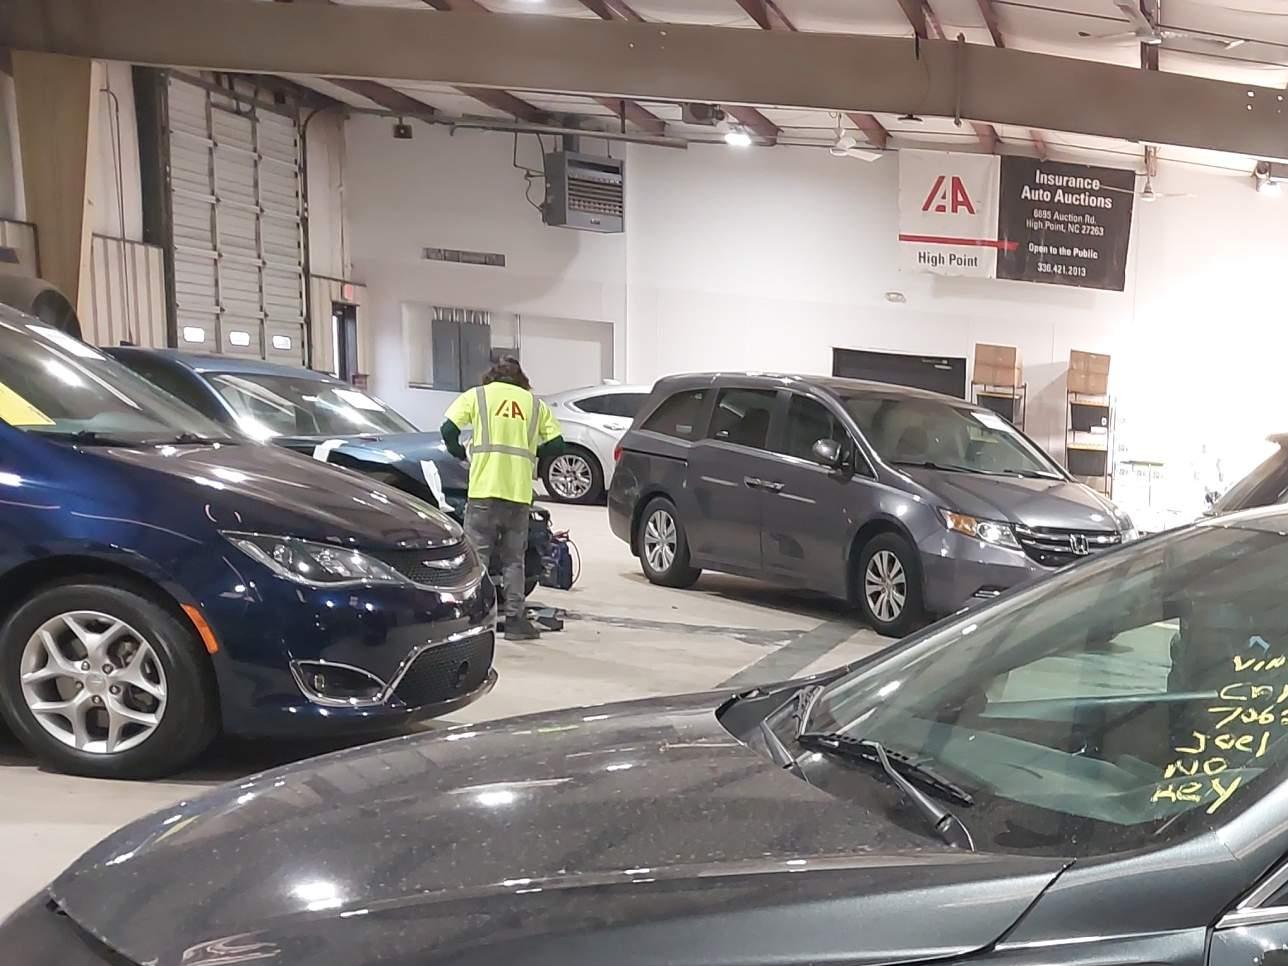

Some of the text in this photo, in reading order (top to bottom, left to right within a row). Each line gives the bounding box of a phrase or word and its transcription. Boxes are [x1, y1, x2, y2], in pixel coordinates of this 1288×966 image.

[1035, 169, 1100, 190] Insurance
[1021, 186, 1113, 209] Auto Auctions
[1053, 211, 1082, 223] Auction
[1084, 214, 1097, 224] Rd.
[1026, 218, 1104, 236] High Point, NC 27263
[1028, 242, 1098, 259] Open to the Public
[918, 252, 978, 267] High Point
